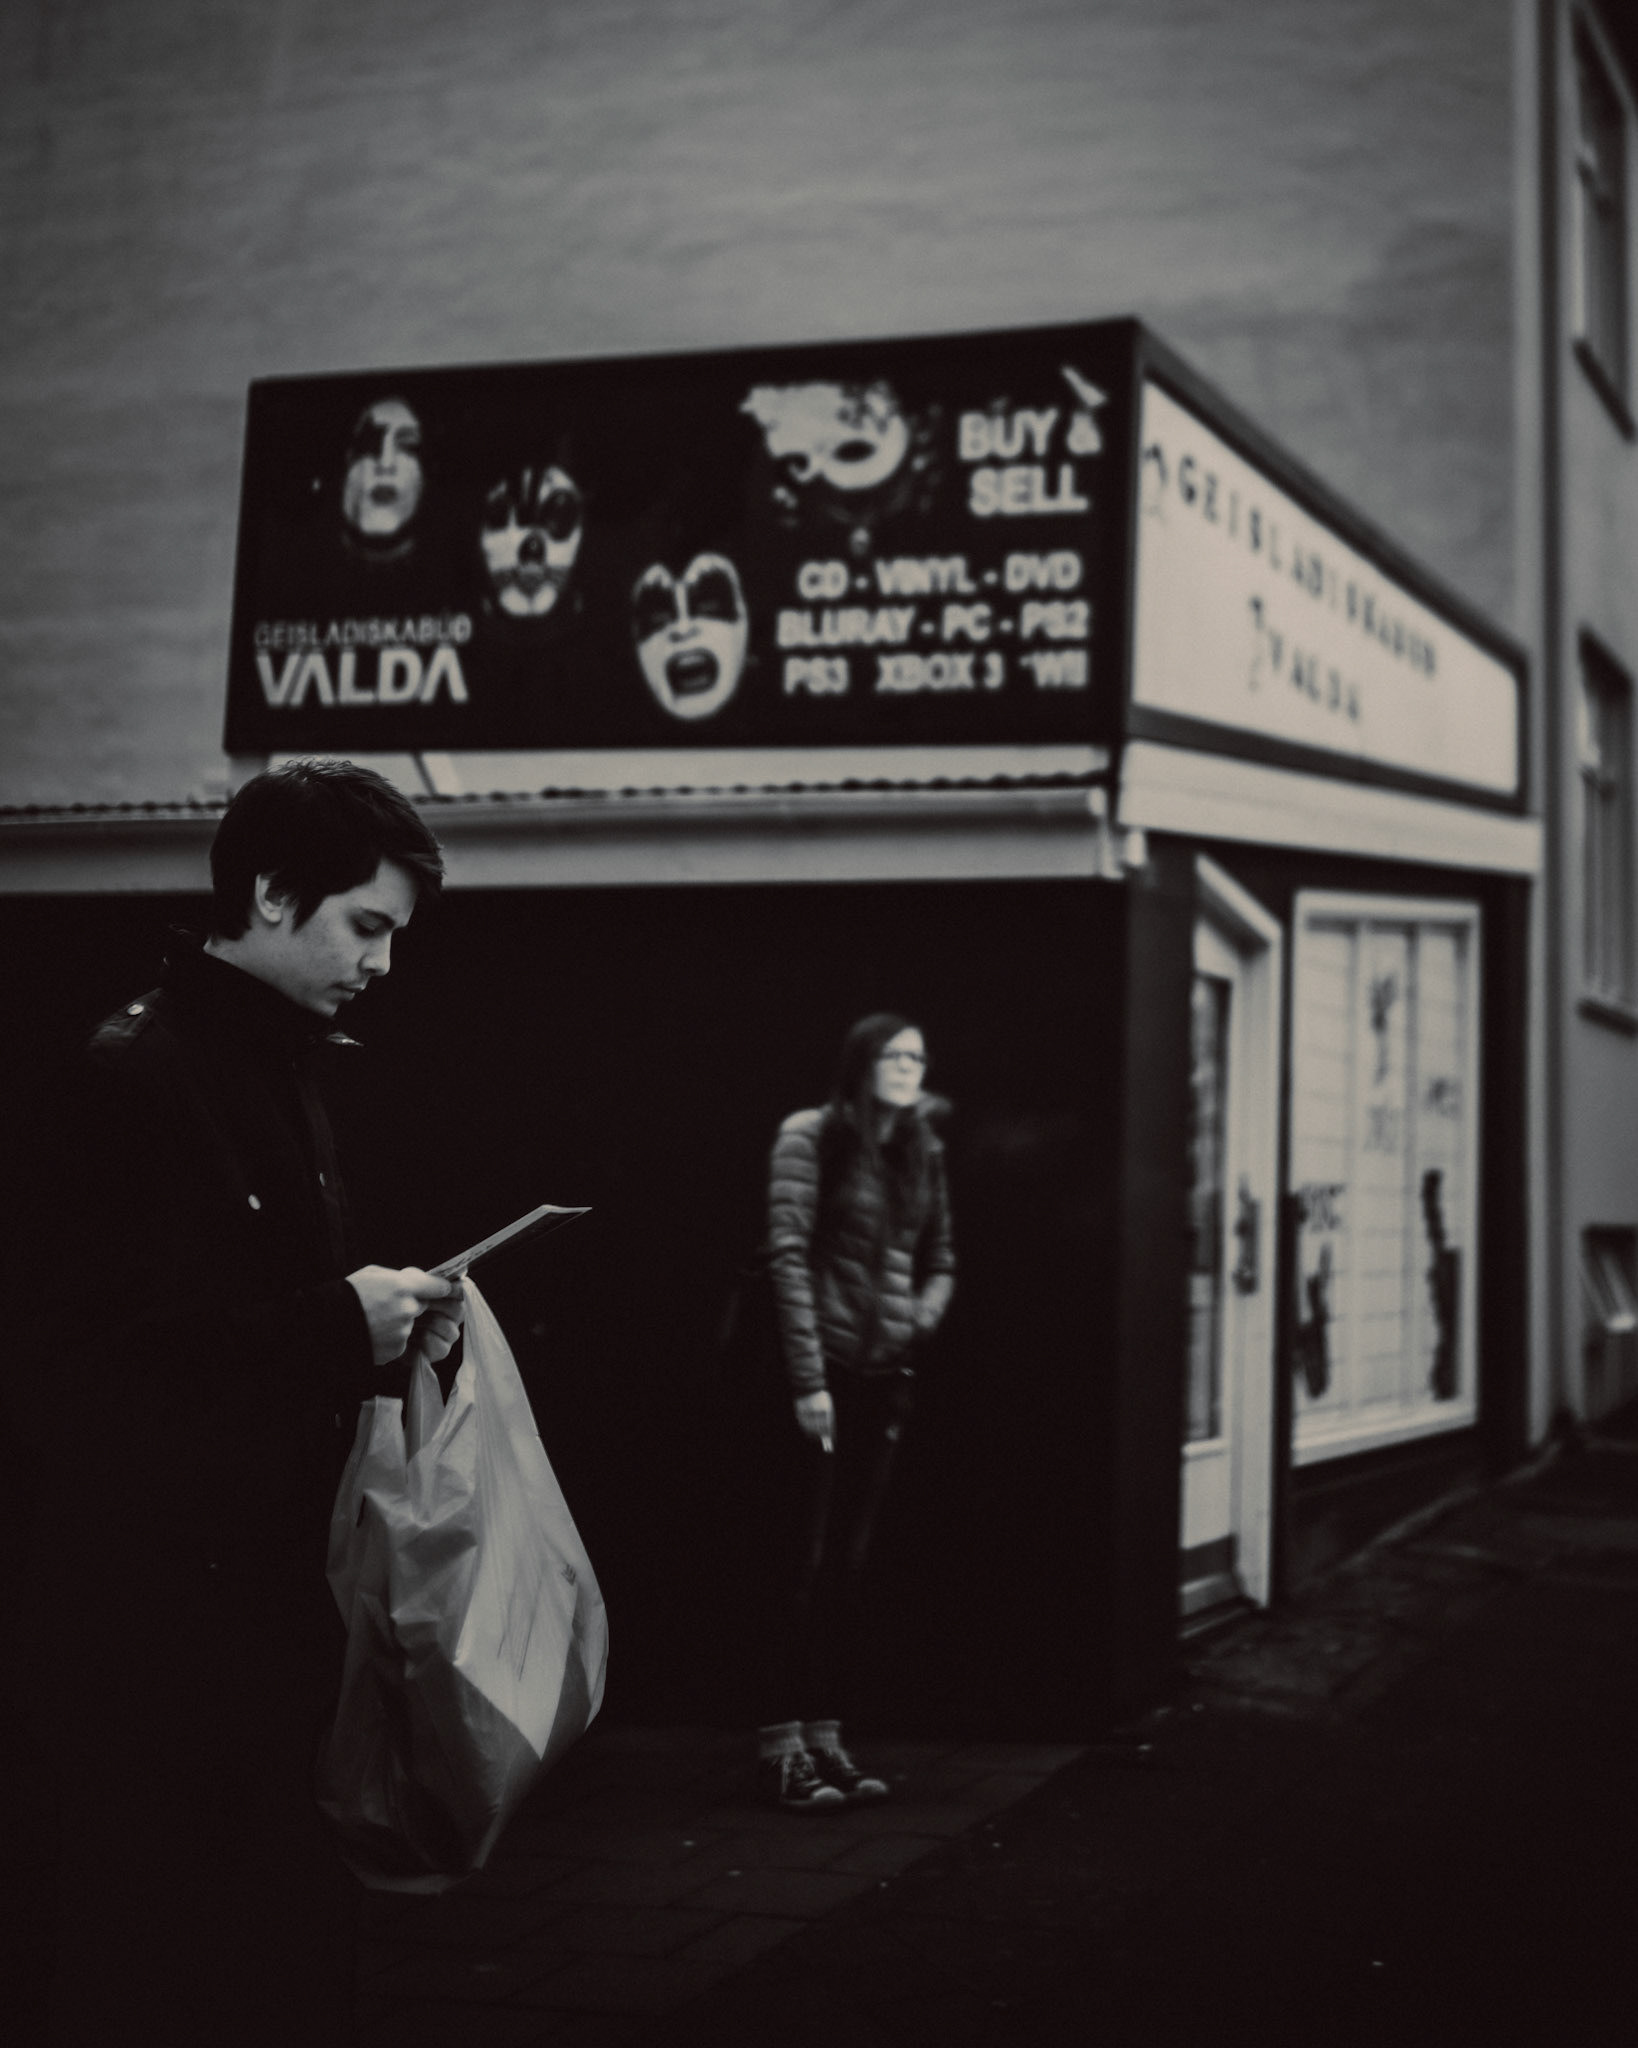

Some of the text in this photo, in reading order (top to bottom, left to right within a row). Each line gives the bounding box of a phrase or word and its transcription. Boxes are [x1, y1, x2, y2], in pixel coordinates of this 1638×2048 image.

[958, 409, 1059, 460] BUY
[968, 464, 1089, 517] SELL
[798, 550, 1083, 600] CD VINYL DVD
[776, 606, 916, 649] BLURAY
[942, 603, 992, 642] PC
[256, 645, 468, 706] VALDA
[875, 652, 975, 692] XBOX
